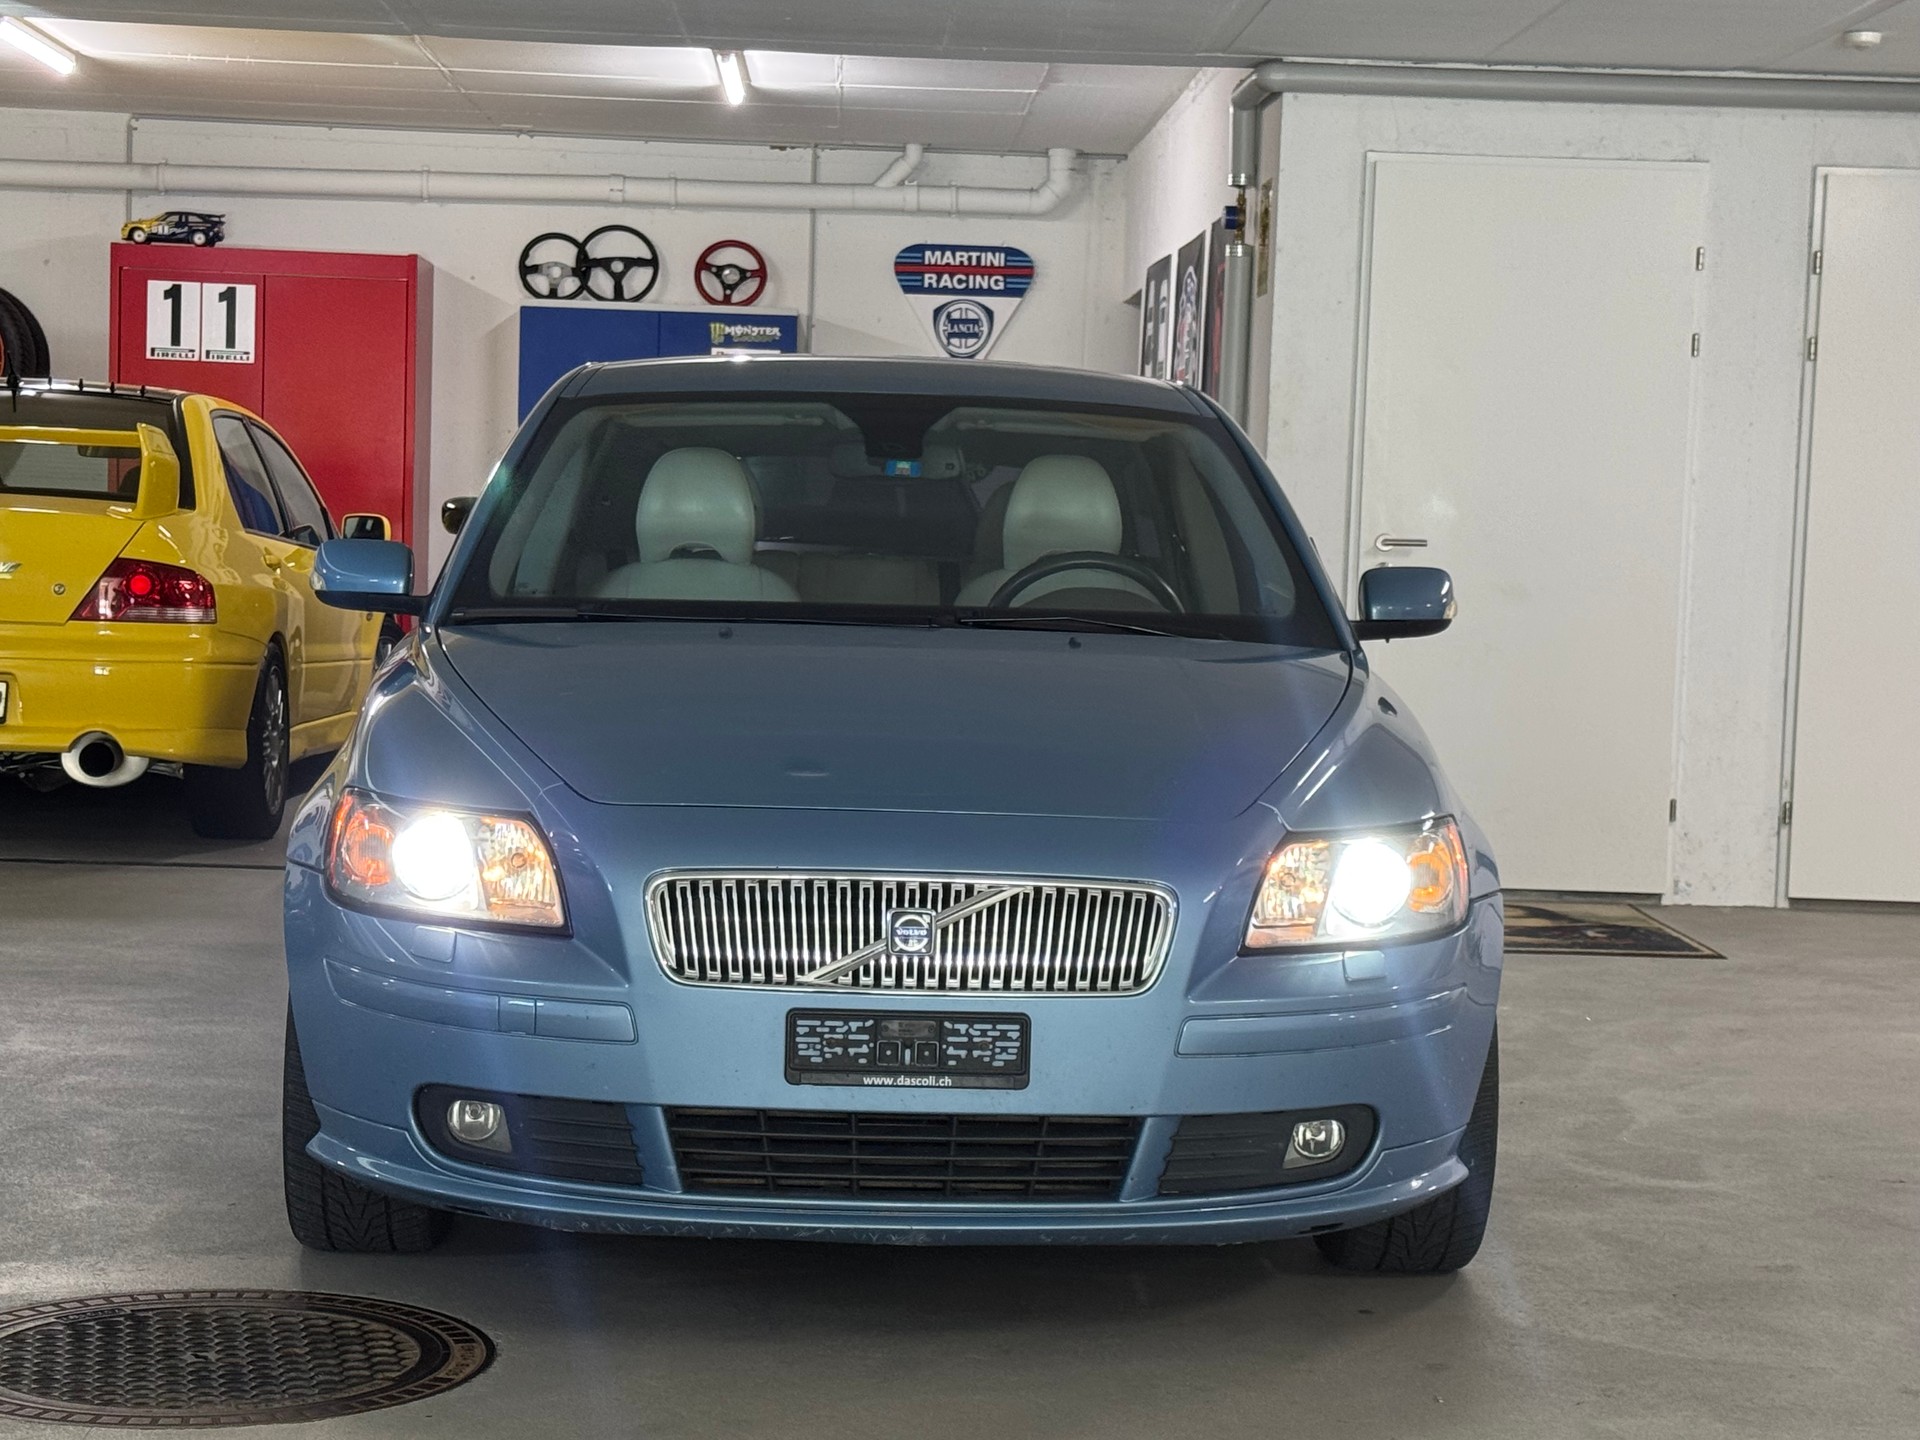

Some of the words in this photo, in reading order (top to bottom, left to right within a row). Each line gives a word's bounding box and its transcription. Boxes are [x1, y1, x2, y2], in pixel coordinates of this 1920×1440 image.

[924, 250, 1006, 267] MARTINI
[923, 273, 1005, 291] RACING
[725, 324, 782, 337] MONSTER
[947, 322, 980, 334] LANCIA
[150, 347, 195, 359] PIRELLI
[205, 349, 250, 361] PIRELLI
[895, 928, 928, 936] VOLVO
[863, 1074, 952, 1087] www.dascoli.ch
